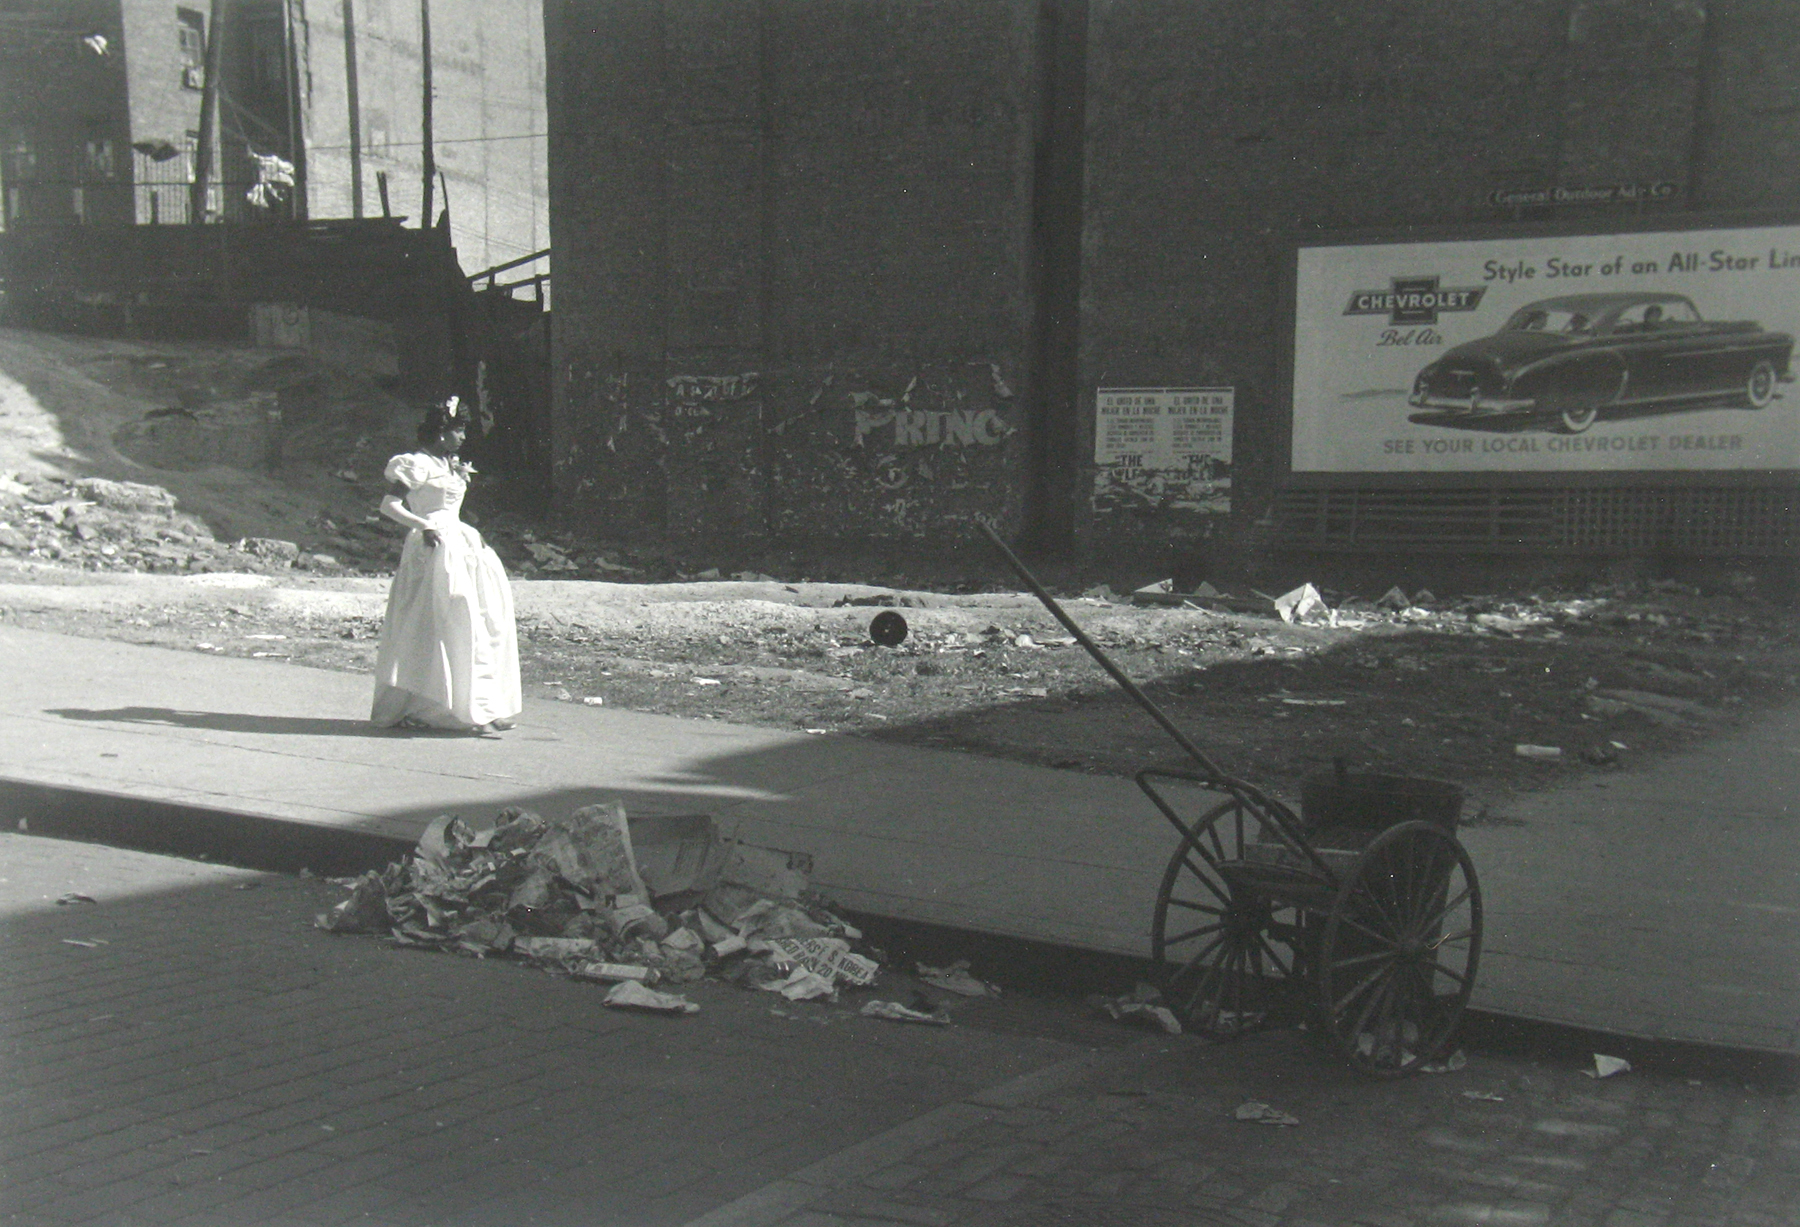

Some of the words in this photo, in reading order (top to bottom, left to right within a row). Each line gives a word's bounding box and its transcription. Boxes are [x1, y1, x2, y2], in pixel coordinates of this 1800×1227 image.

[1482, 260, 1536, 284] Style
[1545, 257, 1593, 279] Star
[1600, 255, 1624, 277] of
[1631, 260, 1658, 275] an
[1668, 250, 1760, 273] All-Star
[1357, 291, 1470, 309] CHEVROLET
[1376, 329, 1411, 346] Bel
[1415, 327, 1443, 345] Air
[1383, 439, 1415, 454] SEE
[1422, 438, 1473, 454] YOUR
[1481, 437, 1540, 453] LOCAL
[1547, 435, 1660, 452] CHEVROLET
[1669, 434, 1743, 451] DEALER
[817, 963, 833, 978] 20
[837, 957, 869, 980] KOREA
